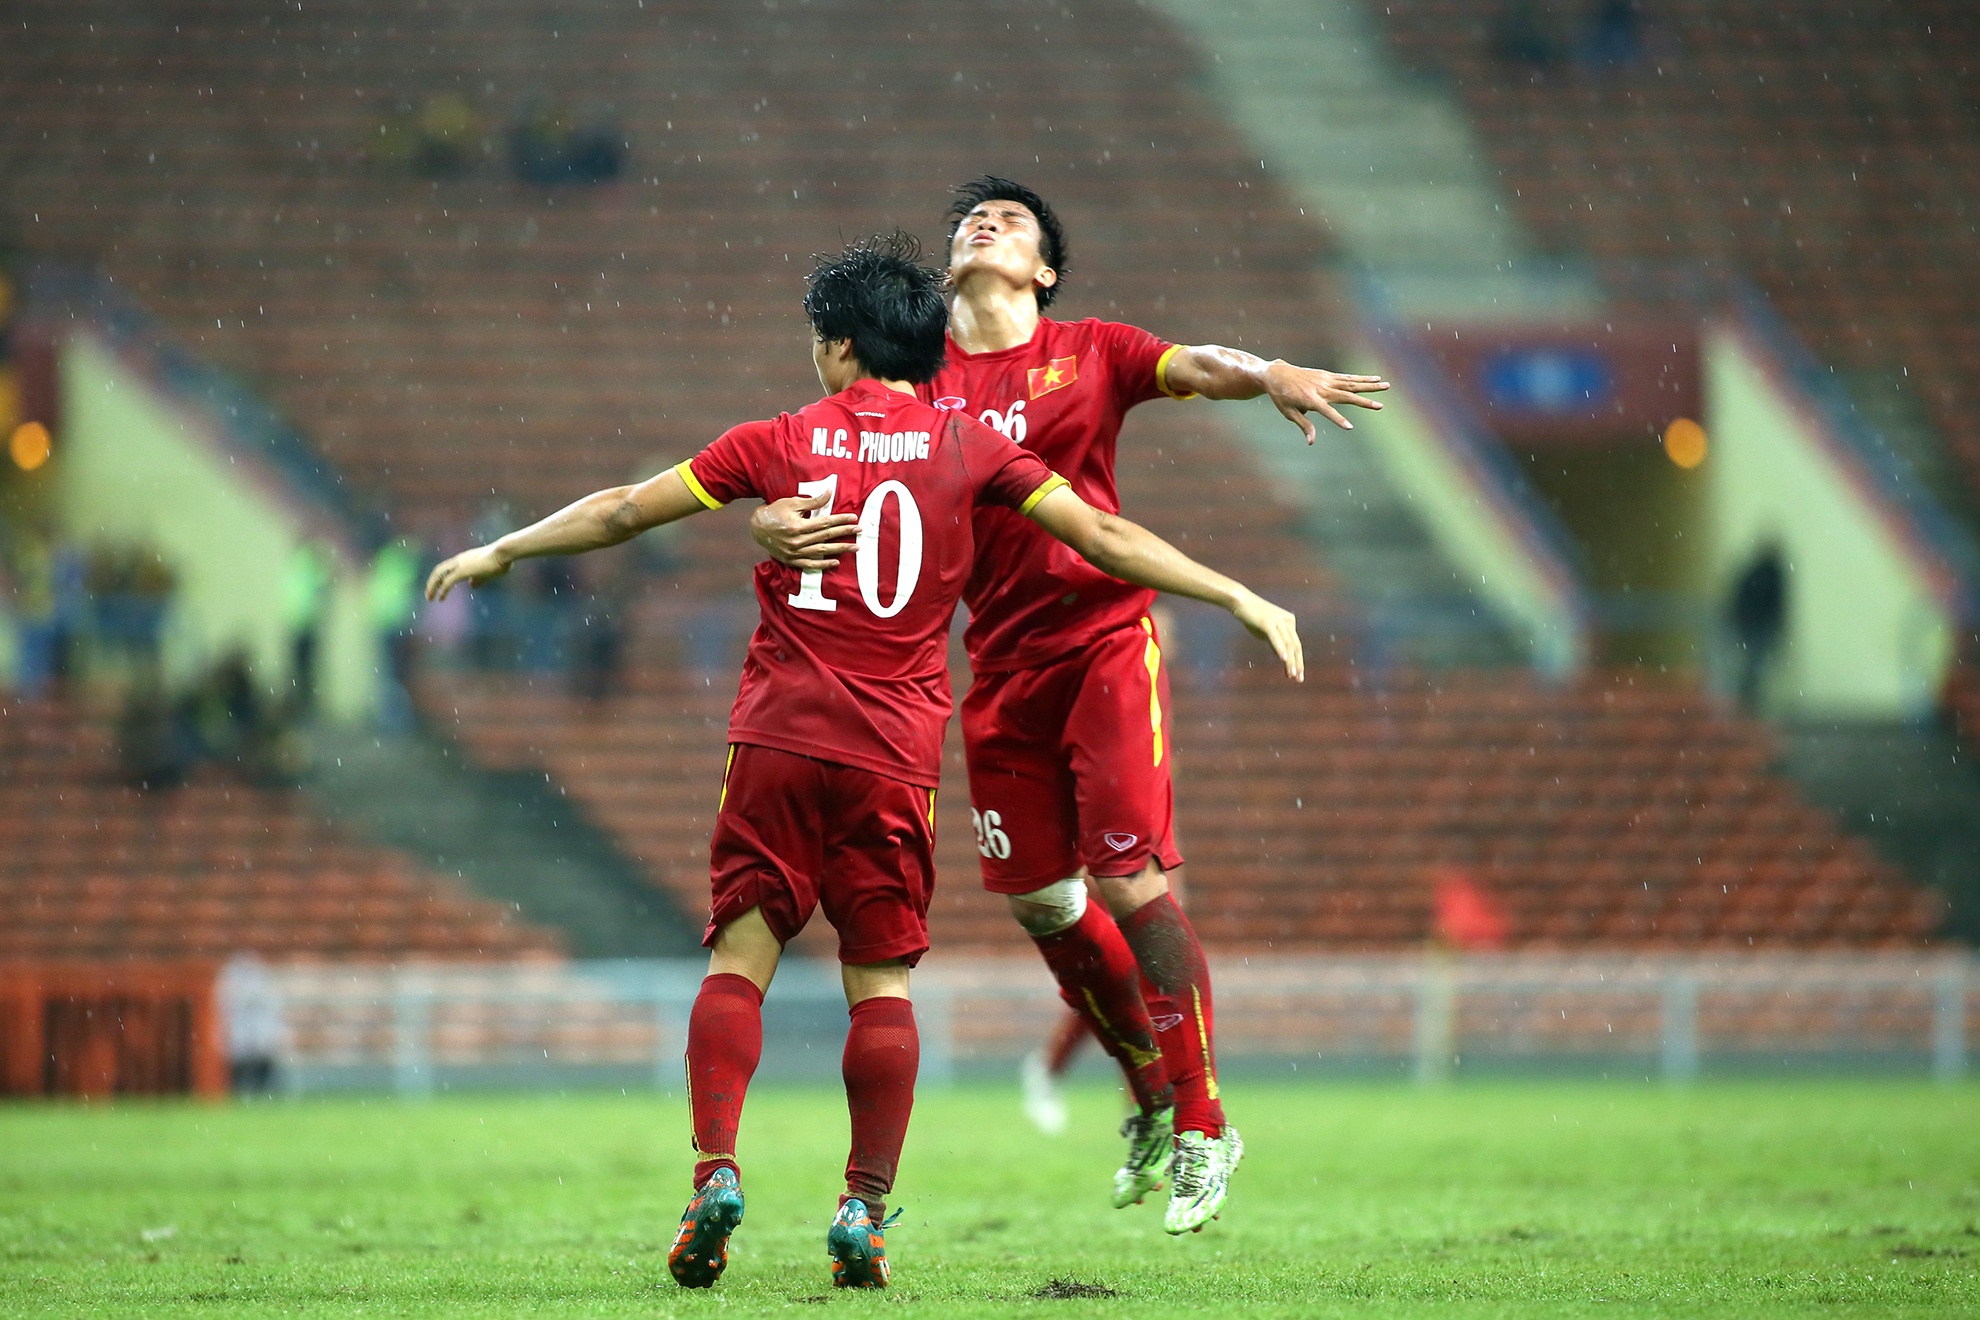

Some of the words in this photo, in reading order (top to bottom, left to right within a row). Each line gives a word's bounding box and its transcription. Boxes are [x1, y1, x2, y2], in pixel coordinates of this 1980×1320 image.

[854, 411, 886, 419] VIETNAM
[811, 427, 853, 460] N.C.
[857, 430, 931, 464] PHUONG
[787, 473, 923, 618] 10
